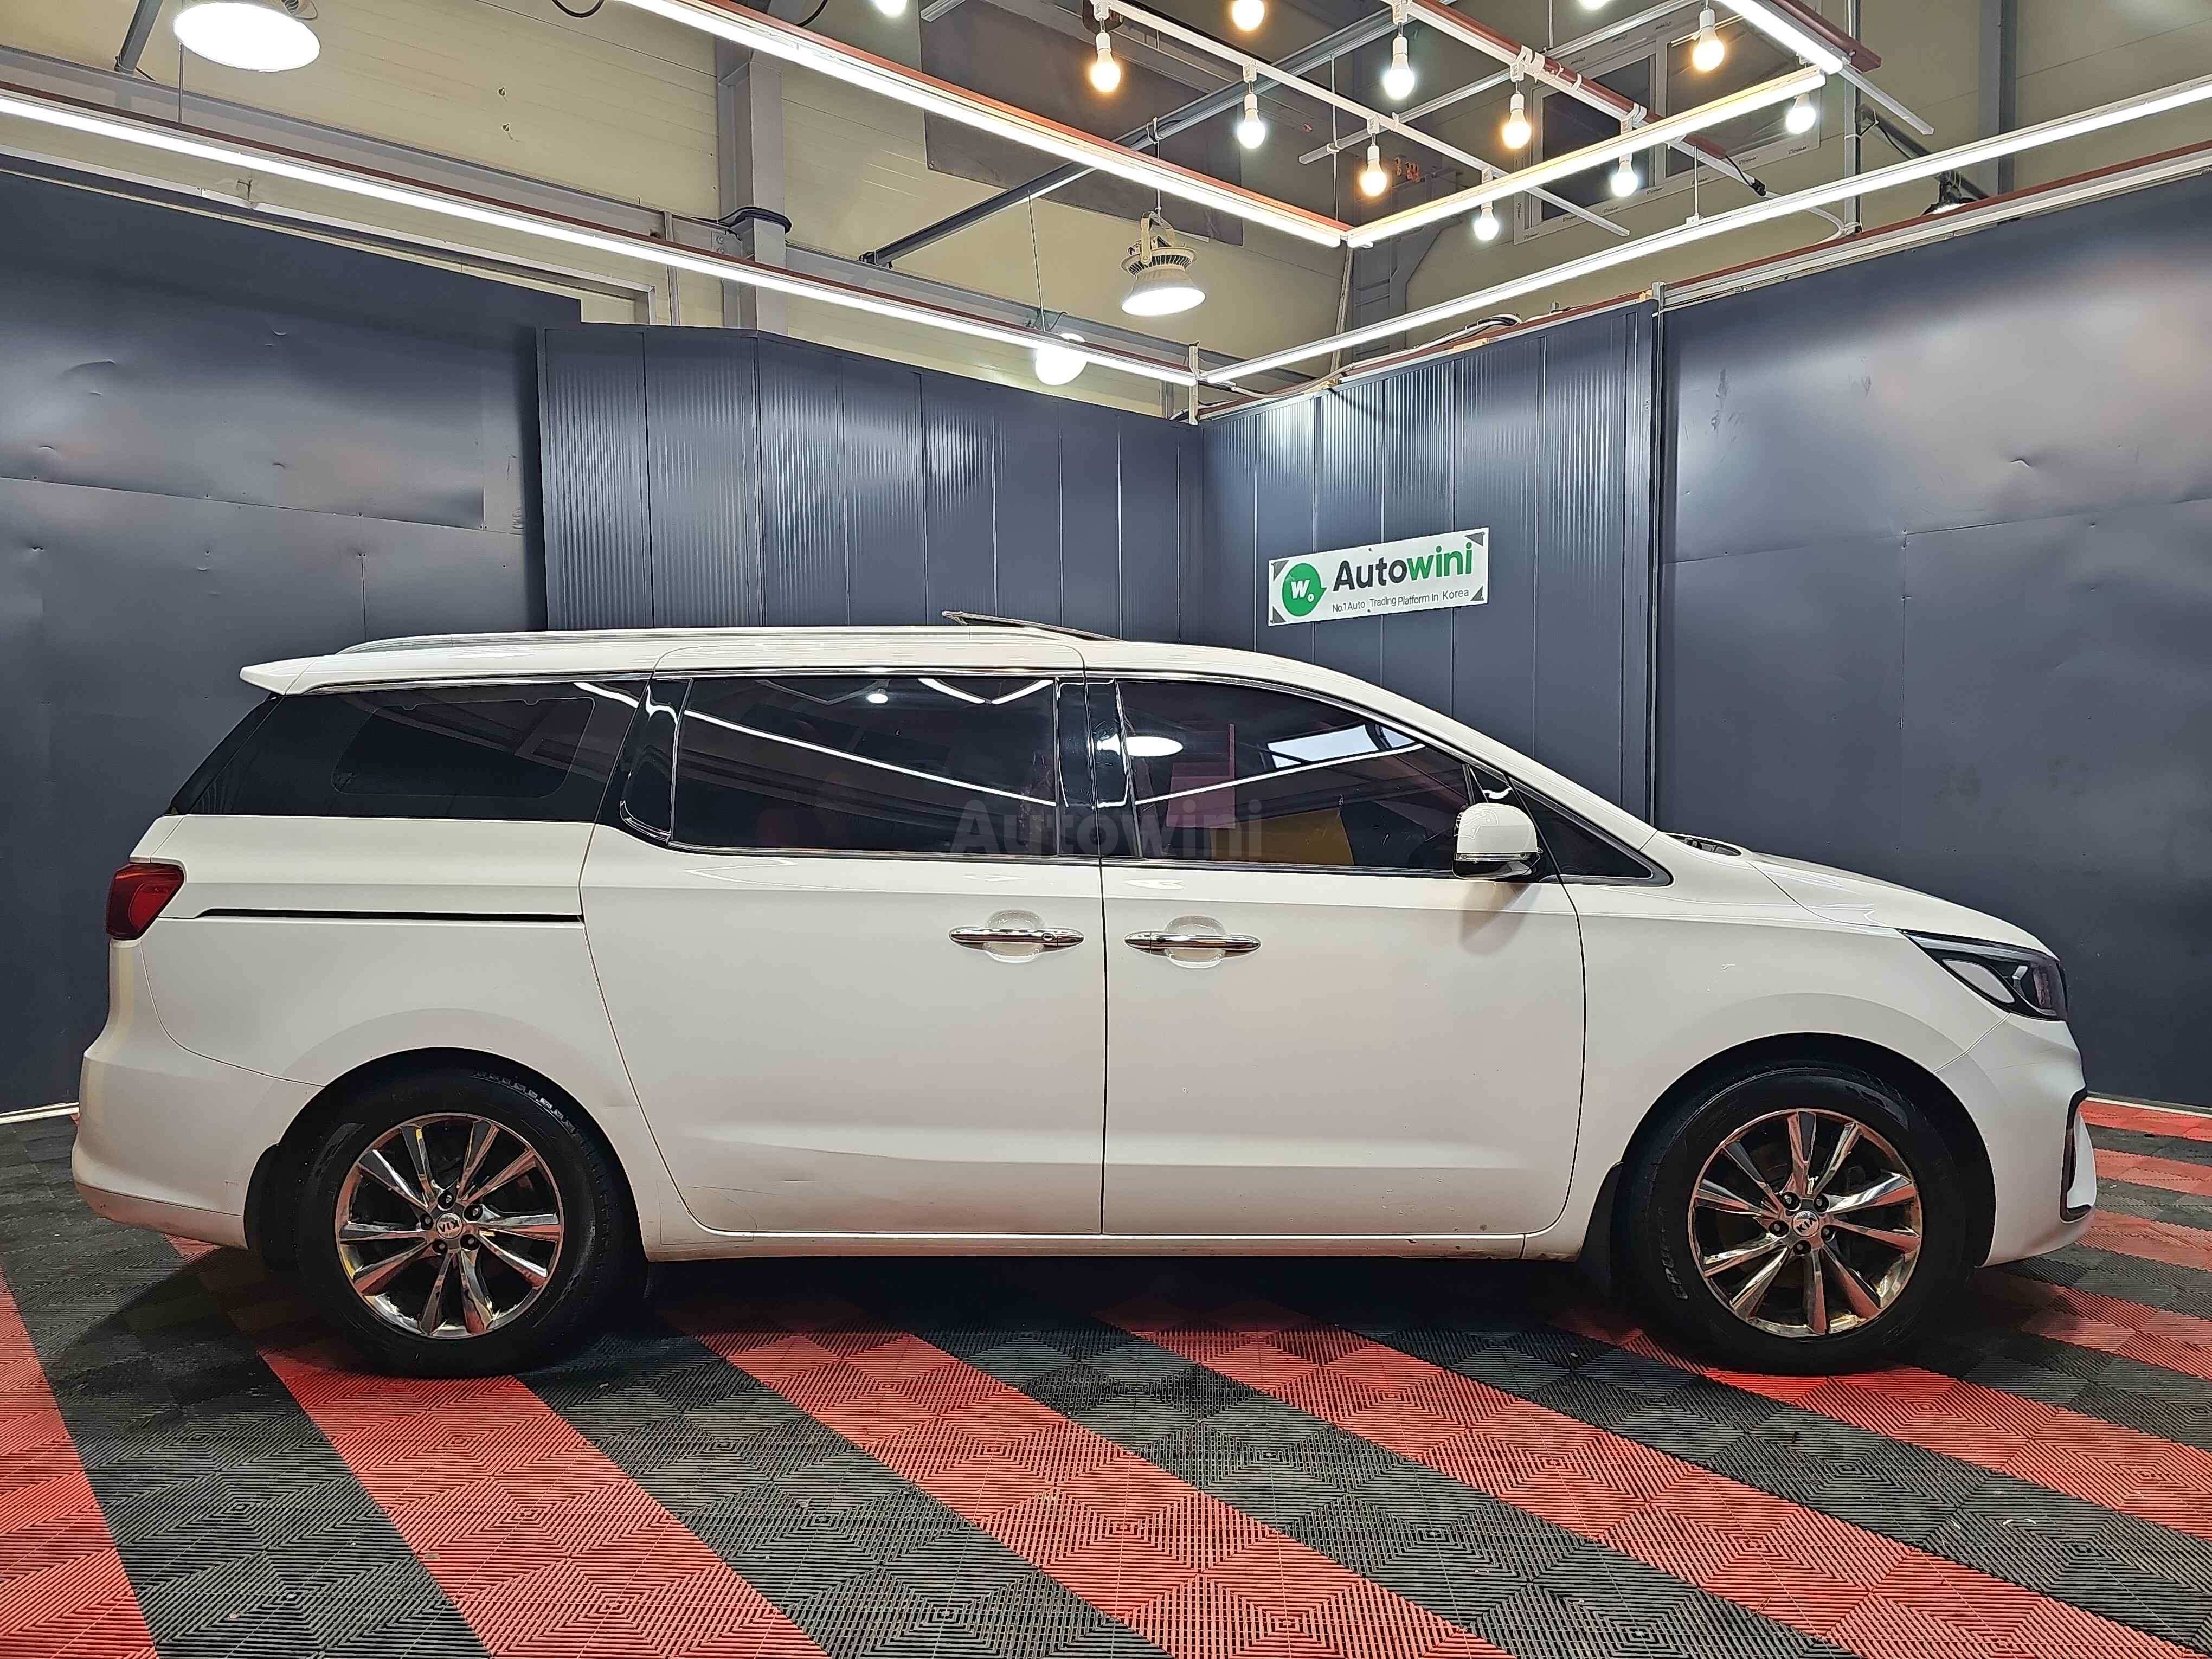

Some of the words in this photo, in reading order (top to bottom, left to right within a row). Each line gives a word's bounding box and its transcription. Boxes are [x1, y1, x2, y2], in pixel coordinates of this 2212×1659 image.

[1333, 542, 1473, 591] Autowini
[1347, 600, 1365, 611] Auto
[1369, 596, 1396, 608] Trading
[1398, 594, 1430, 606] Platform
[1442, 589, 1469, 600] Korea
[439, 1220, 460, 1232] KIA
[1796, 1217, 1817, 1233] KIA
